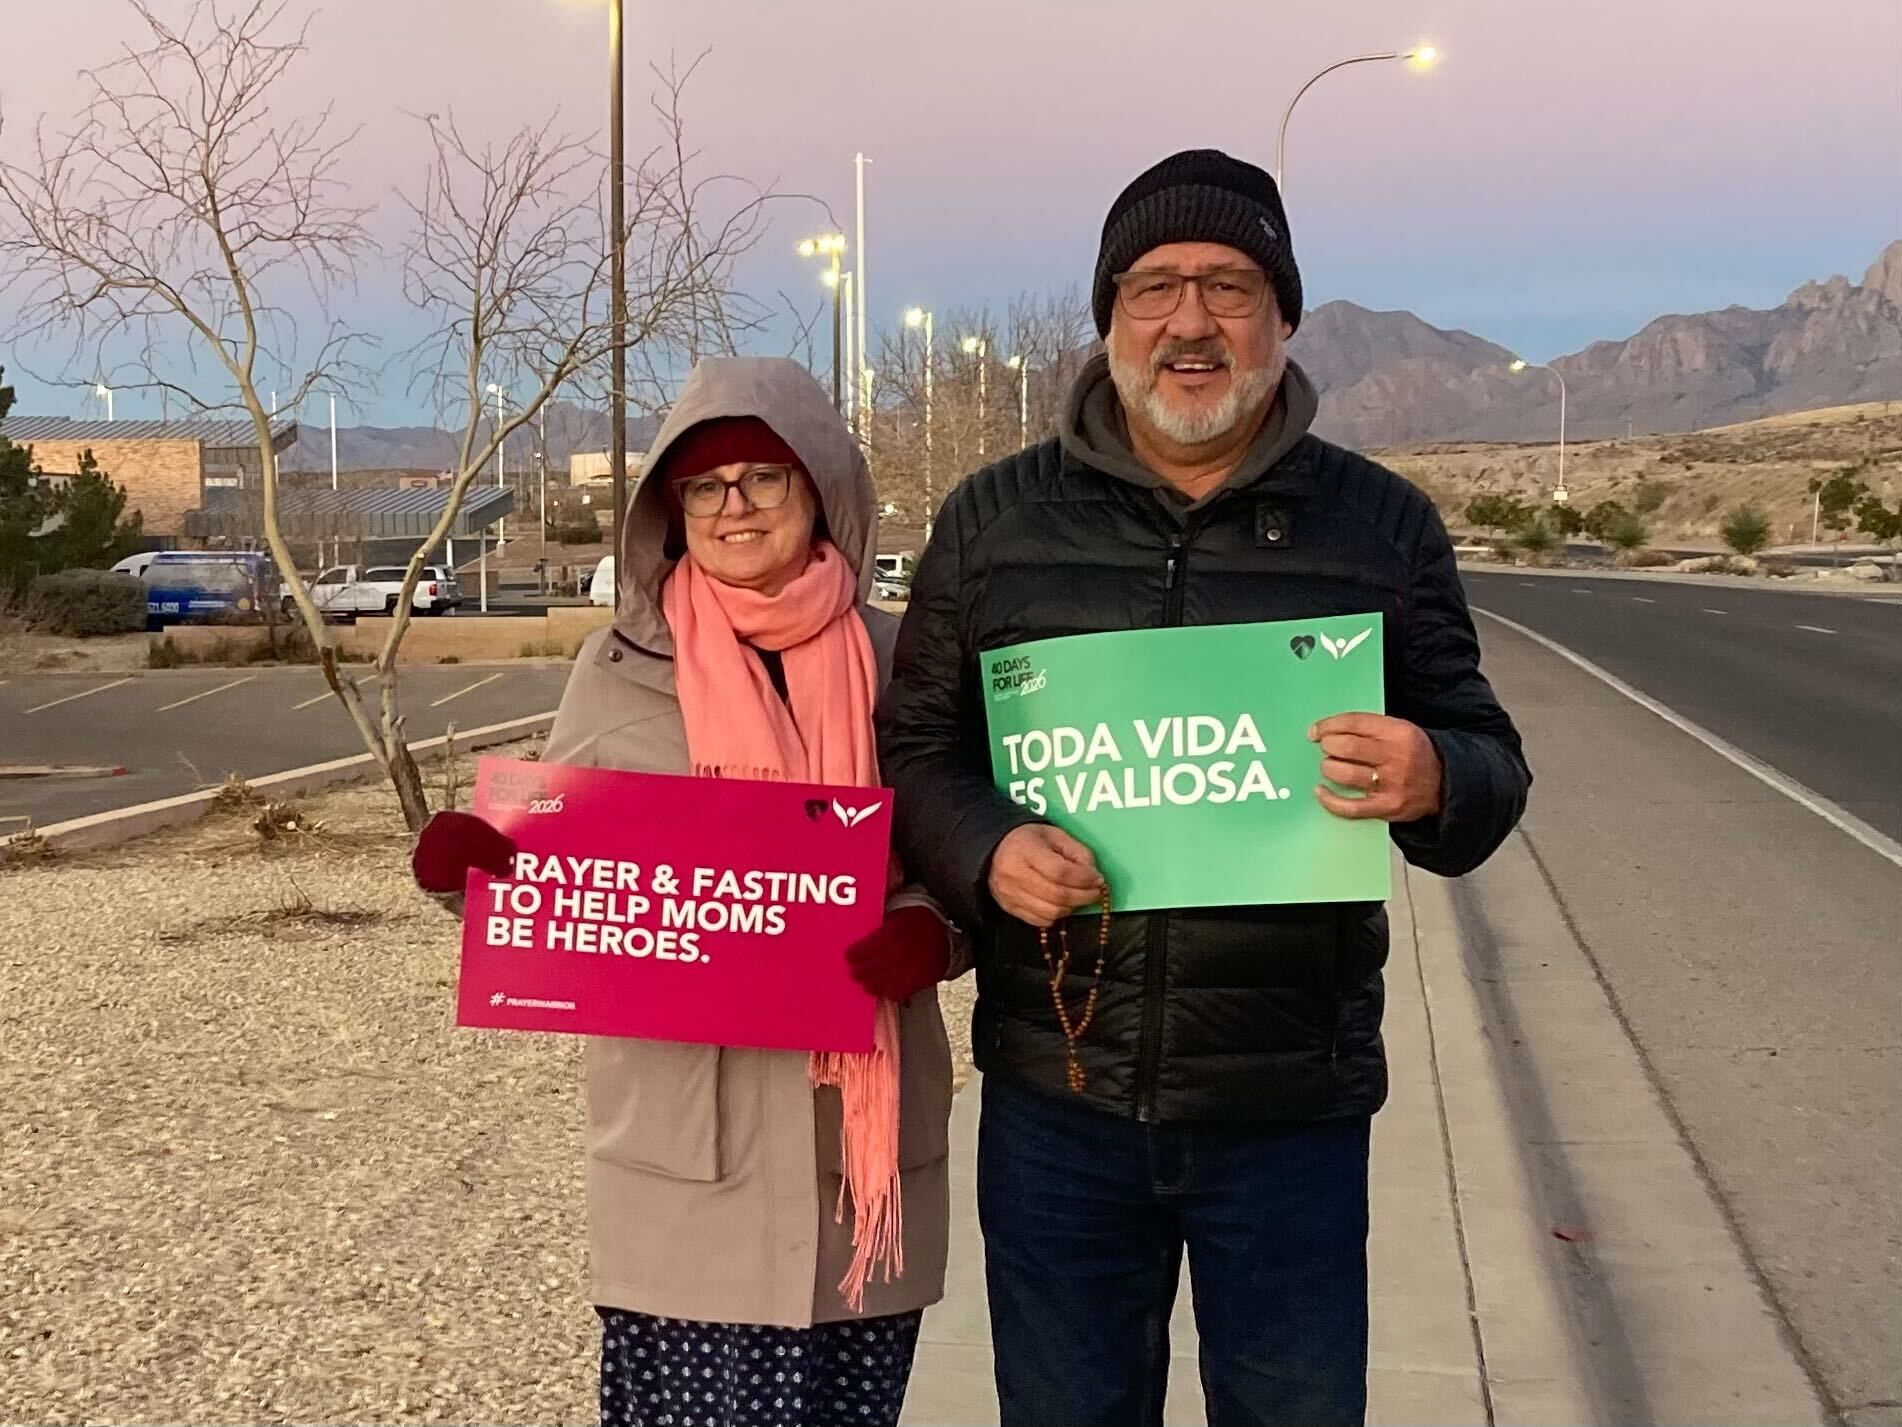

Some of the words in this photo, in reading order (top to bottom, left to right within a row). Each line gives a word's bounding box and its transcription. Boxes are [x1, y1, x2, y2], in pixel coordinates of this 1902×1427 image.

[992, 661, 1003, 675] 40
[1003, 656, 1031, 673] DAYS
[993, 676, 1013, 692] FOR
[1020, 669, 1047, 697] 2026
[1003, 722, 1123, 775] TODA
[1133, 713, 1267, 758] VIDA
[527, 793, 565, 815] 2026
[1055, 760, 1291, 814] VALIOSA.
[508, 852, 641, 892] RAYER
[651, 864, 681, 895] &
[692, 867, 857, 906] FASTING
[487, 882, 542, 915] TO
[553, 887, 651, 924] HELP
[661, 898, 787, 936] MOMS
[486, 915, 535, 949] BE
[546, 919, 711, 964] HEROES.
